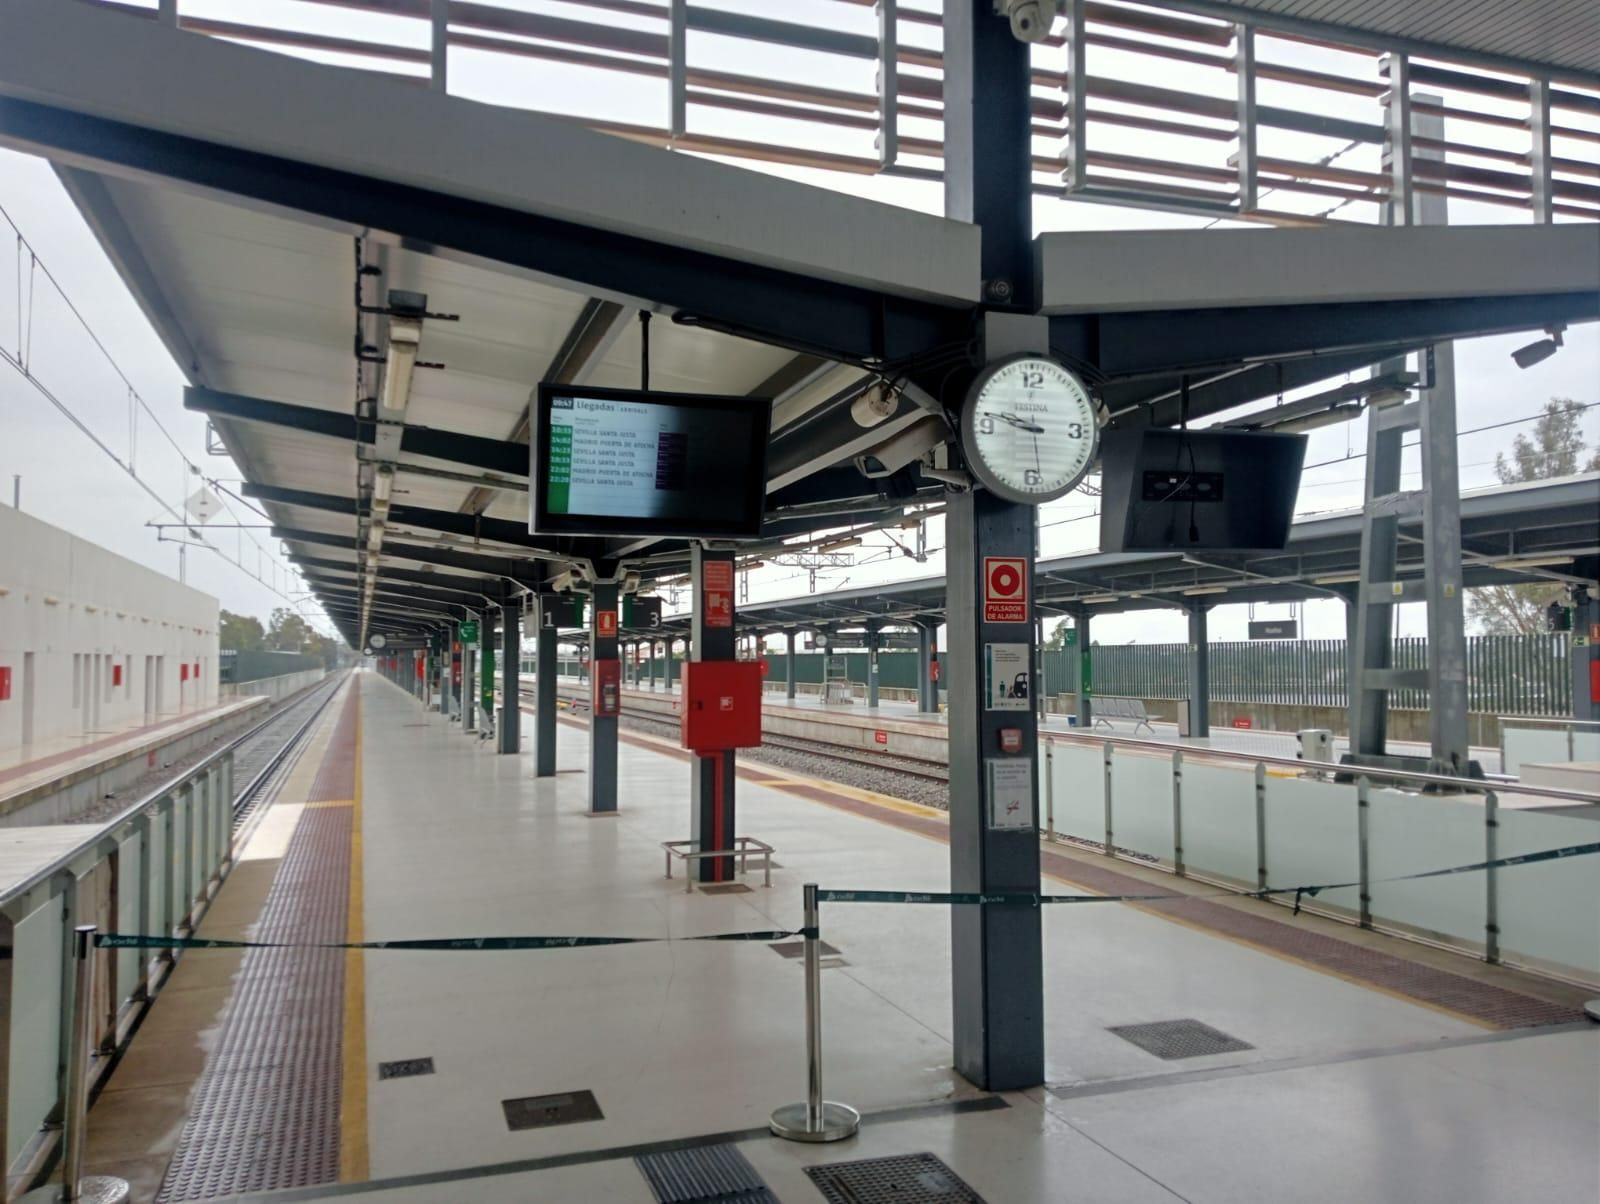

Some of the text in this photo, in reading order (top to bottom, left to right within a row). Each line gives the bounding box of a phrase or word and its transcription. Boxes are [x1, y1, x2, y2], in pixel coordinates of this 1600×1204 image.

[1022, 372, 1044, 390] 12
[577, 400, 615, 412] Llegadas
[980, 418, 995, 435] 9
[1068, 423, 1083, 440] 3
[1024, 469, 1040, 486] 6
[543, 611, 555, 628] 1
[650, 612, 660, 628] 3
[426, 638, 432, 648] 1
